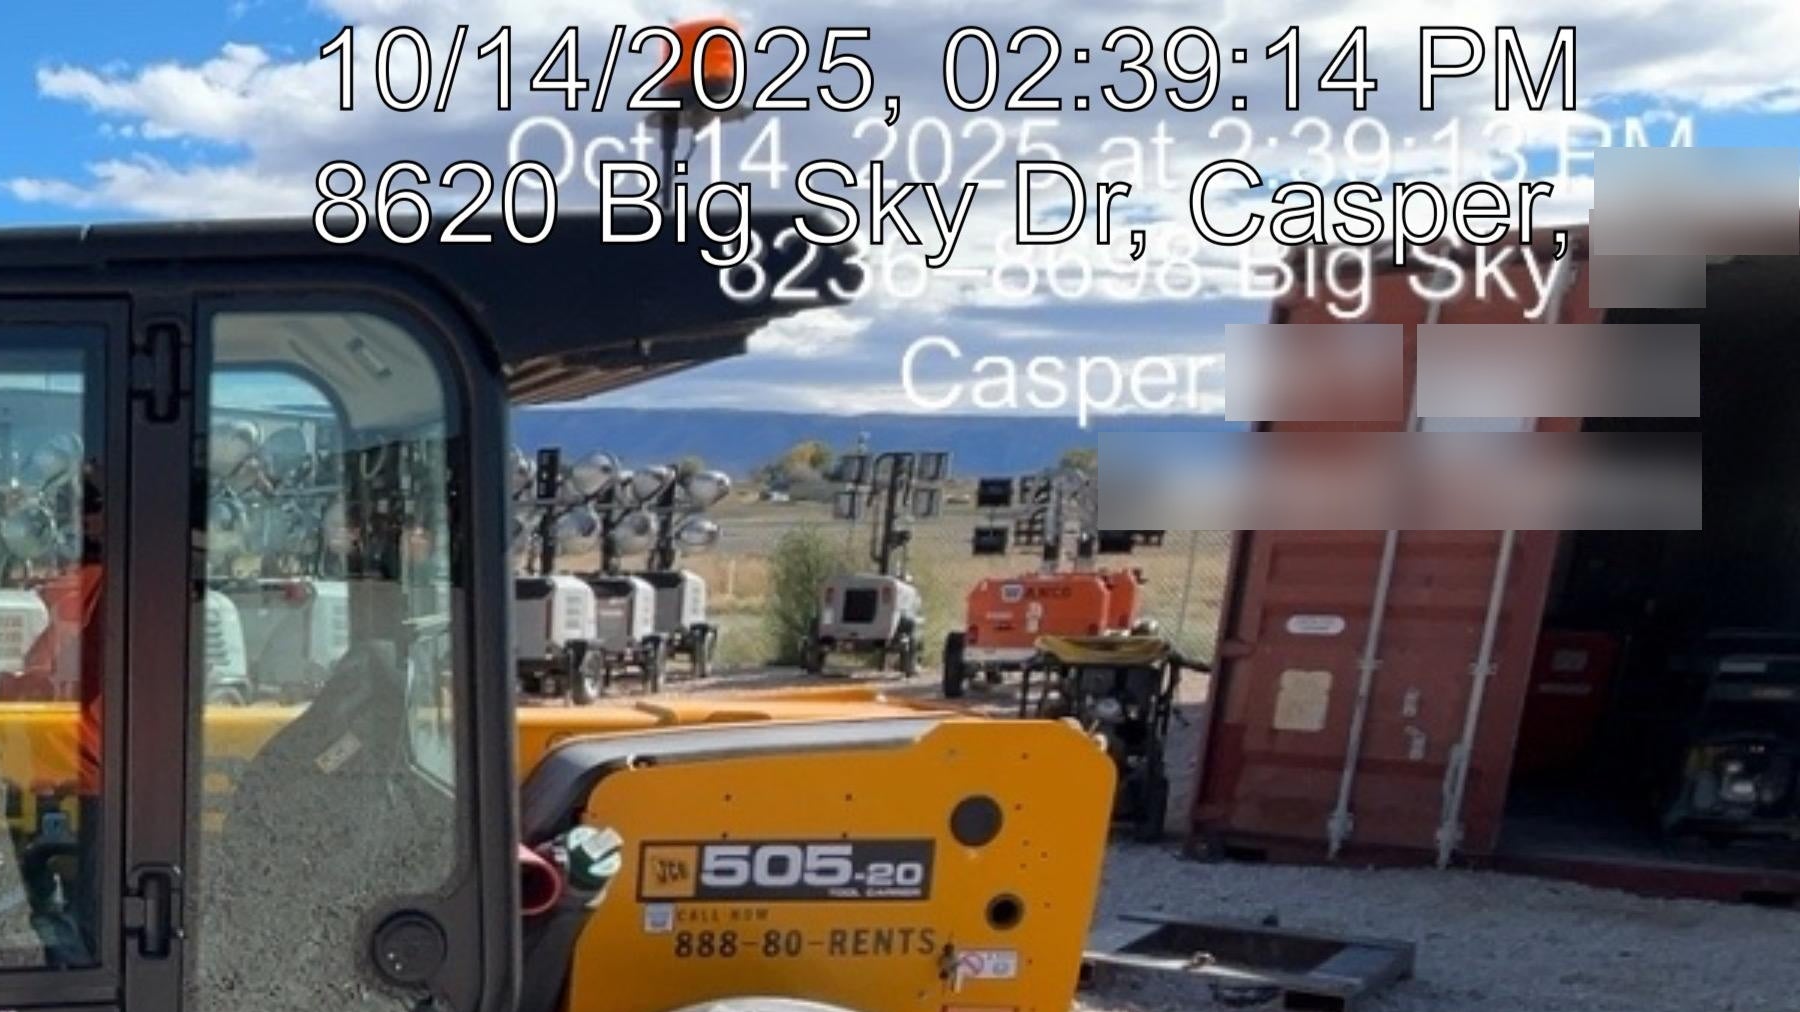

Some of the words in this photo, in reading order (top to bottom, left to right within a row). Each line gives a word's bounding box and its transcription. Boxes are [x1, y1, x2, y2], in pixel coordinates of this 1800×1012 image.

[702, 844, 923, 888] 505-20
[676, 910, 720, 922] CALL
[731, 908, 769, 921] NOW
[674, 928, 936, 958] 888-80-RENTS
